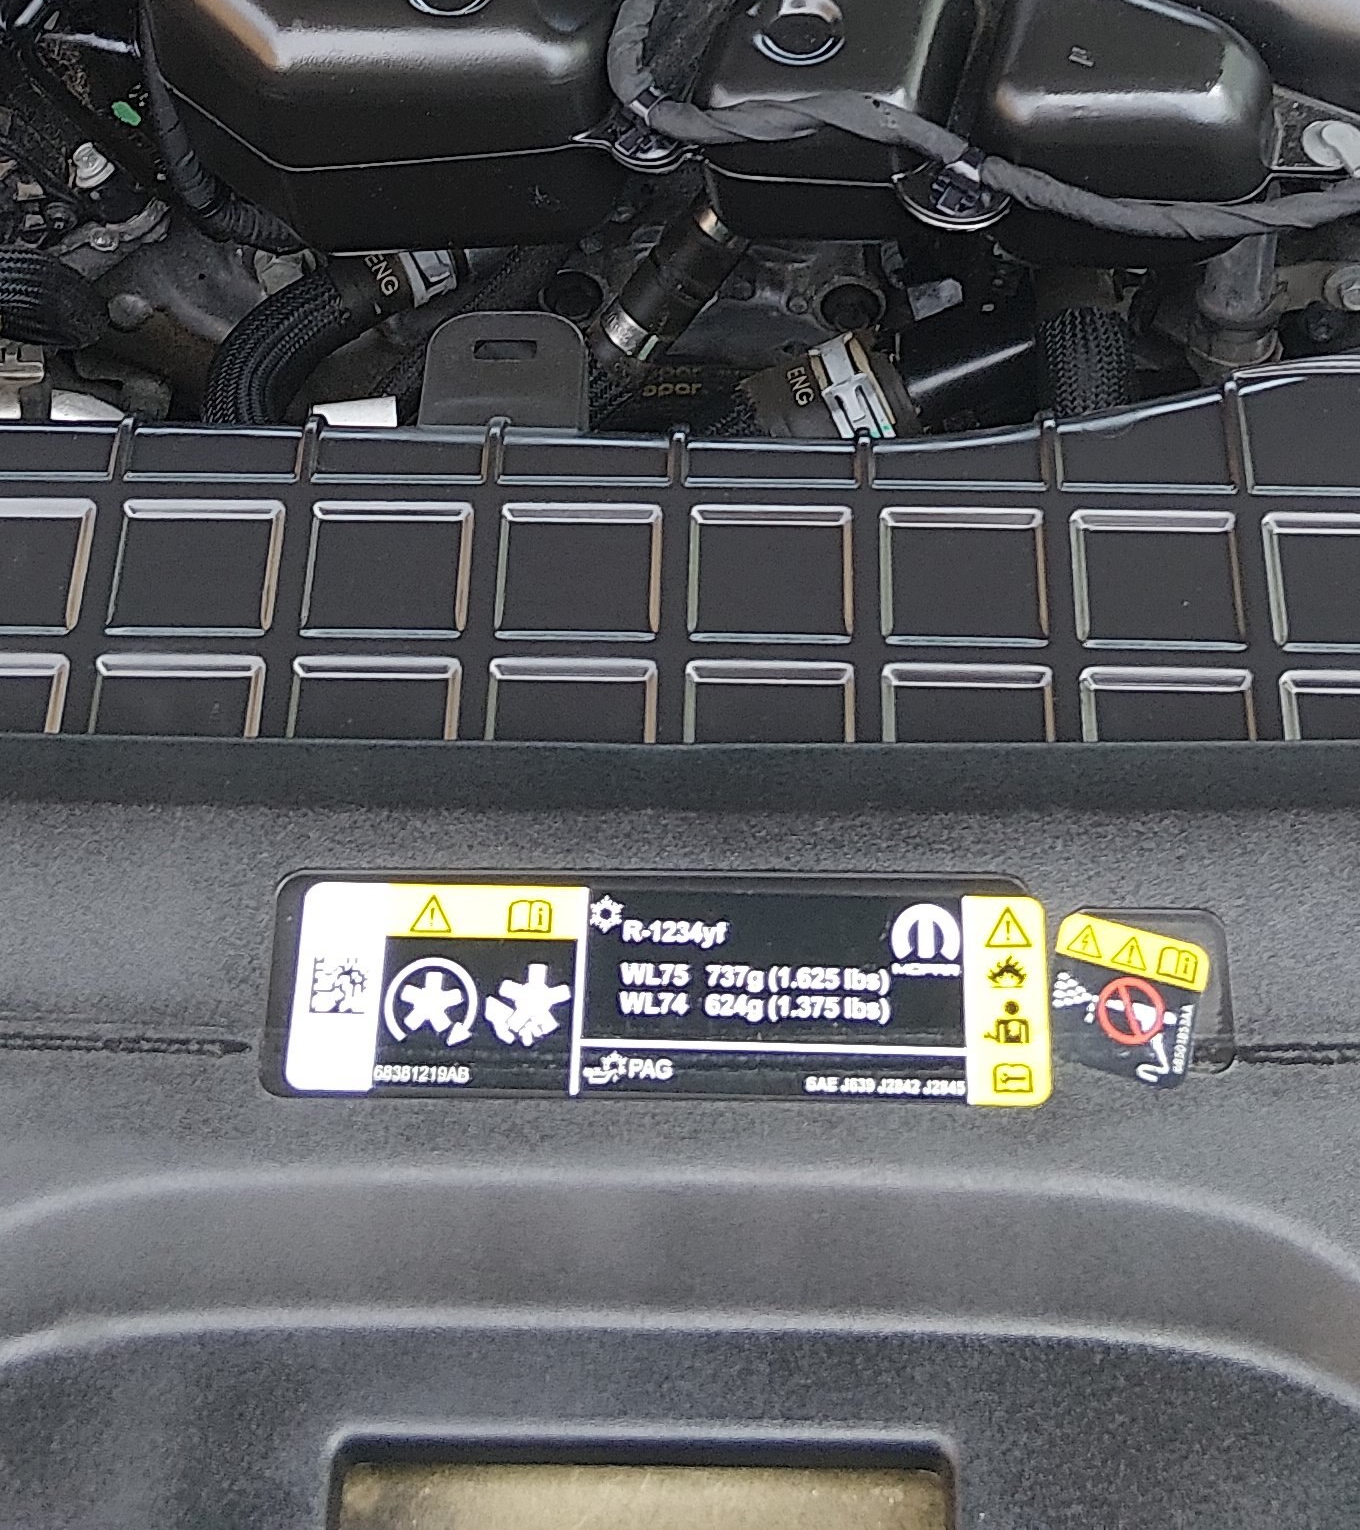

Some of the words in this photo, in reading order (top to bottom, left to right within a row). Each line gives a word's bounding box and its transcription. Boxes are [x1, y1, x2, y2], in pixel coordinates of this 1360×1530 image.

[364, 254, 399, 296] ENG
[785, 366, 815, 406] ENG
[621, 920, 729, 949] R-1234yf
[620, 962, 690, 986] WL75
[705, 965, 766, 992] 737g
[768, 966, 840, 992] (1.625
[843, 968, 890, 995] lbs)
[619, 992, 690, 1015] WL74
[705, 995, 765, 1021] 624g
[767, 996, 840, 1022] (1.375
[843, 998, 890, 1024] lbs)
[628, 1059, 673, 1080] PAG
[805, 1076, 839, 1092] SAE
